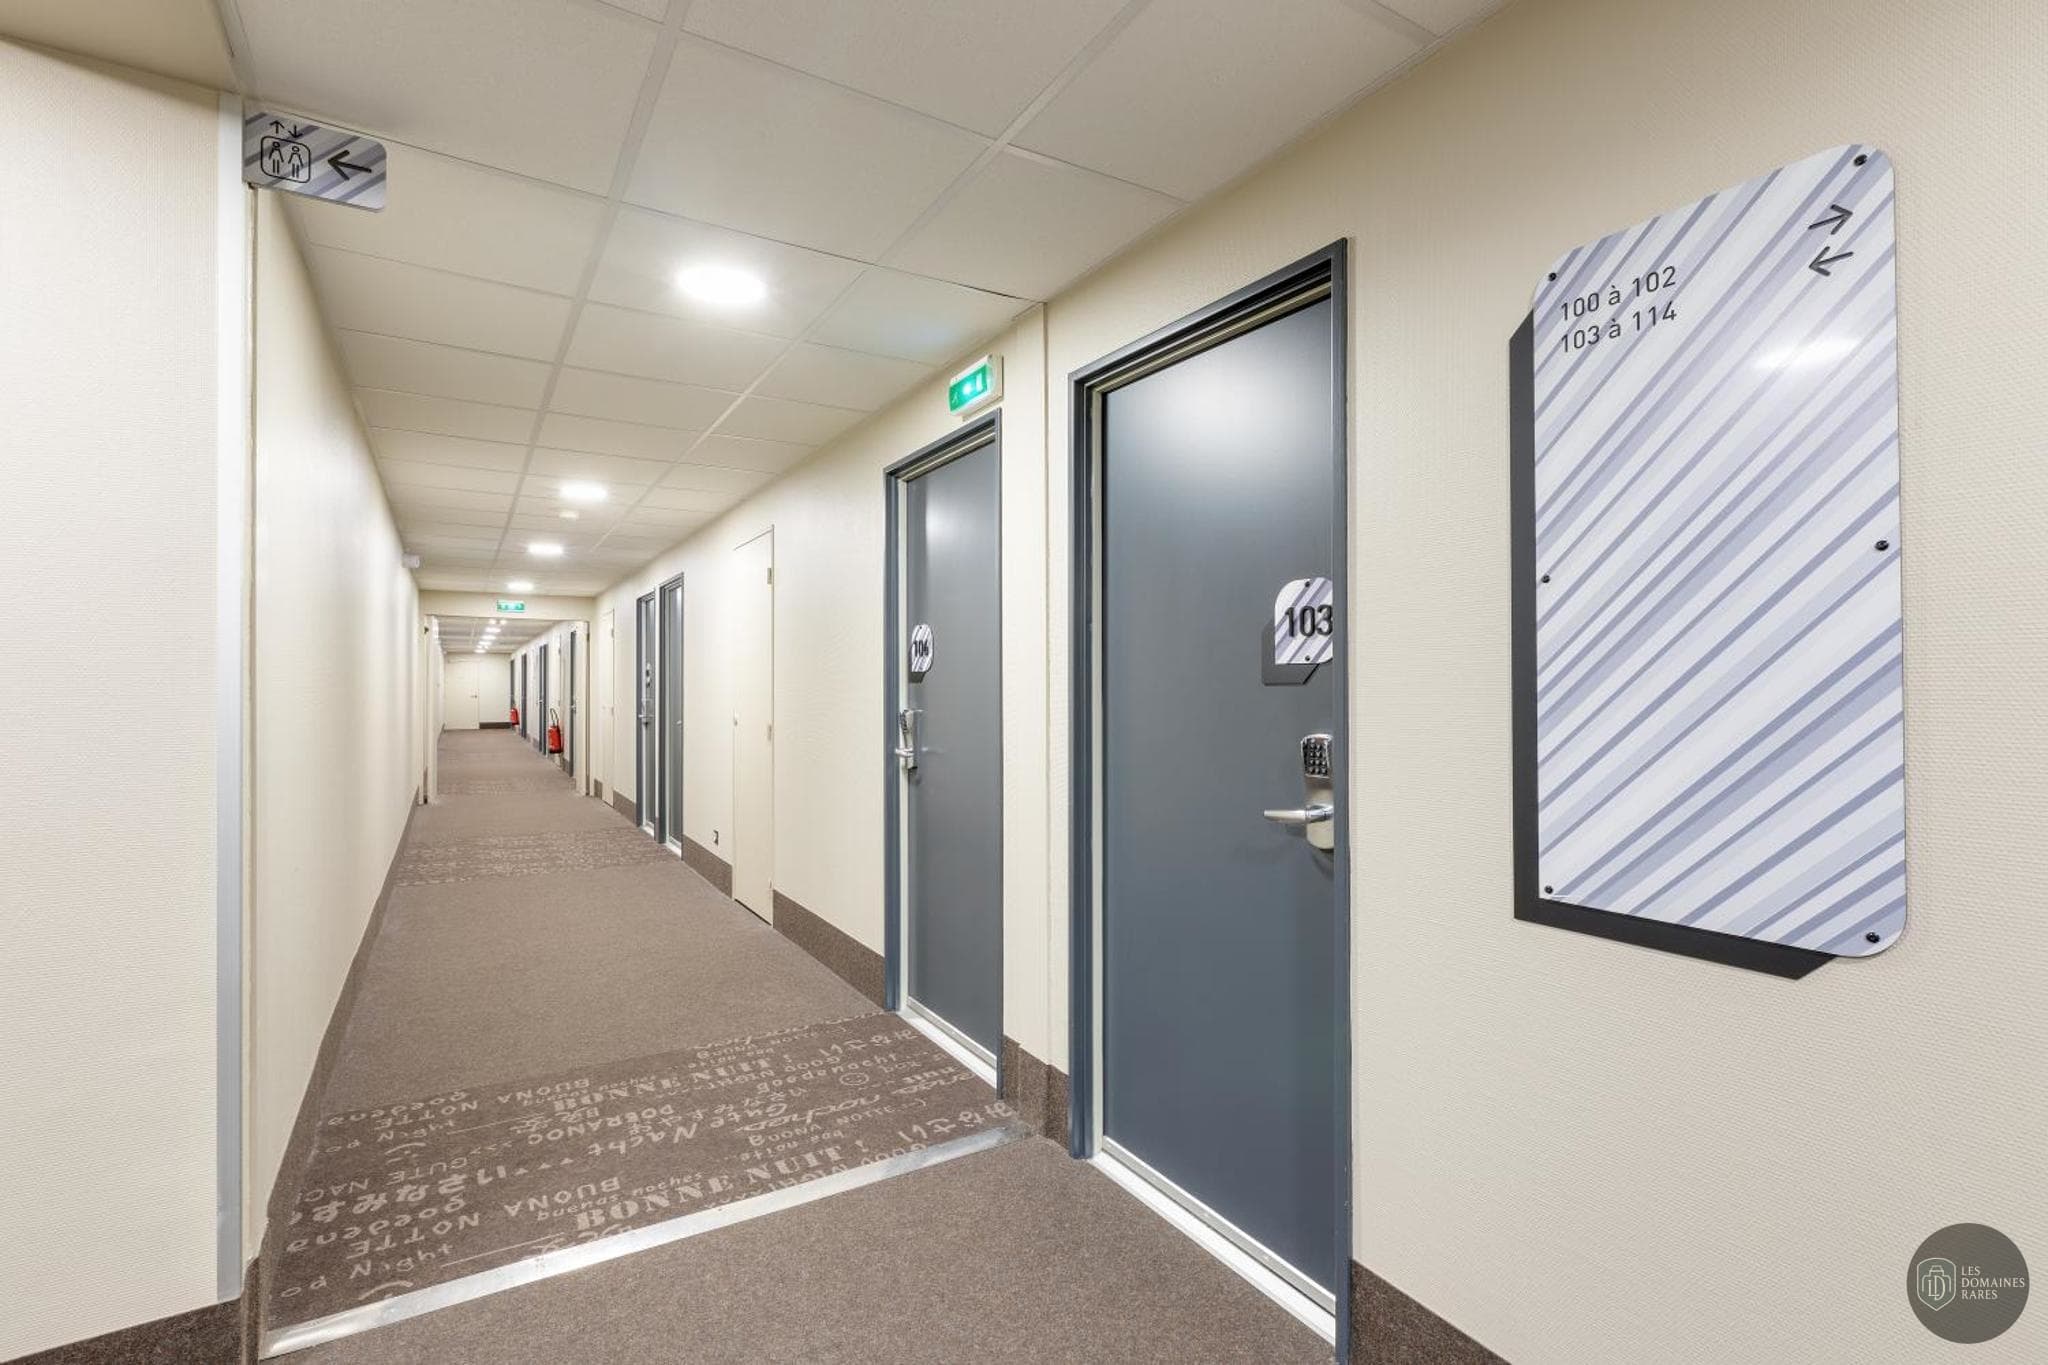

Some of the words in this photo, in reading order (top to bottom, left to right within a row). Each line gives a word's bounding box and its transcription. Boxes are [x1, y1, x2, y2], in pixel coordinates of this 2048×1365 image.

[1561, 292, 1600, 321] 100
[1608, 285, 1621, 306] à
[1632, 266, 1676, 297] 102
[1561, 325, 1600, 353] 103
[1608, 318, 1621, 339] à
[1633, 300, 1677, 331] 114
[1285, 605, 1333, 637] 103
[913, 639, 929, 657] 106
[709, 1102, 787, 1128] Gute
[588, 1122, 697, 1155] Nacht
[291, 1164, 506, 1223] すみなさい
[295, 1177, 369, 1204] NAC
[504, 1176, 620, 1216] BUONA
[576, 1175, 732, 1229] BONNE
[745, 1145, 841, 1183] NUIT
[347, 1211, 480, 1258] NOTTE
